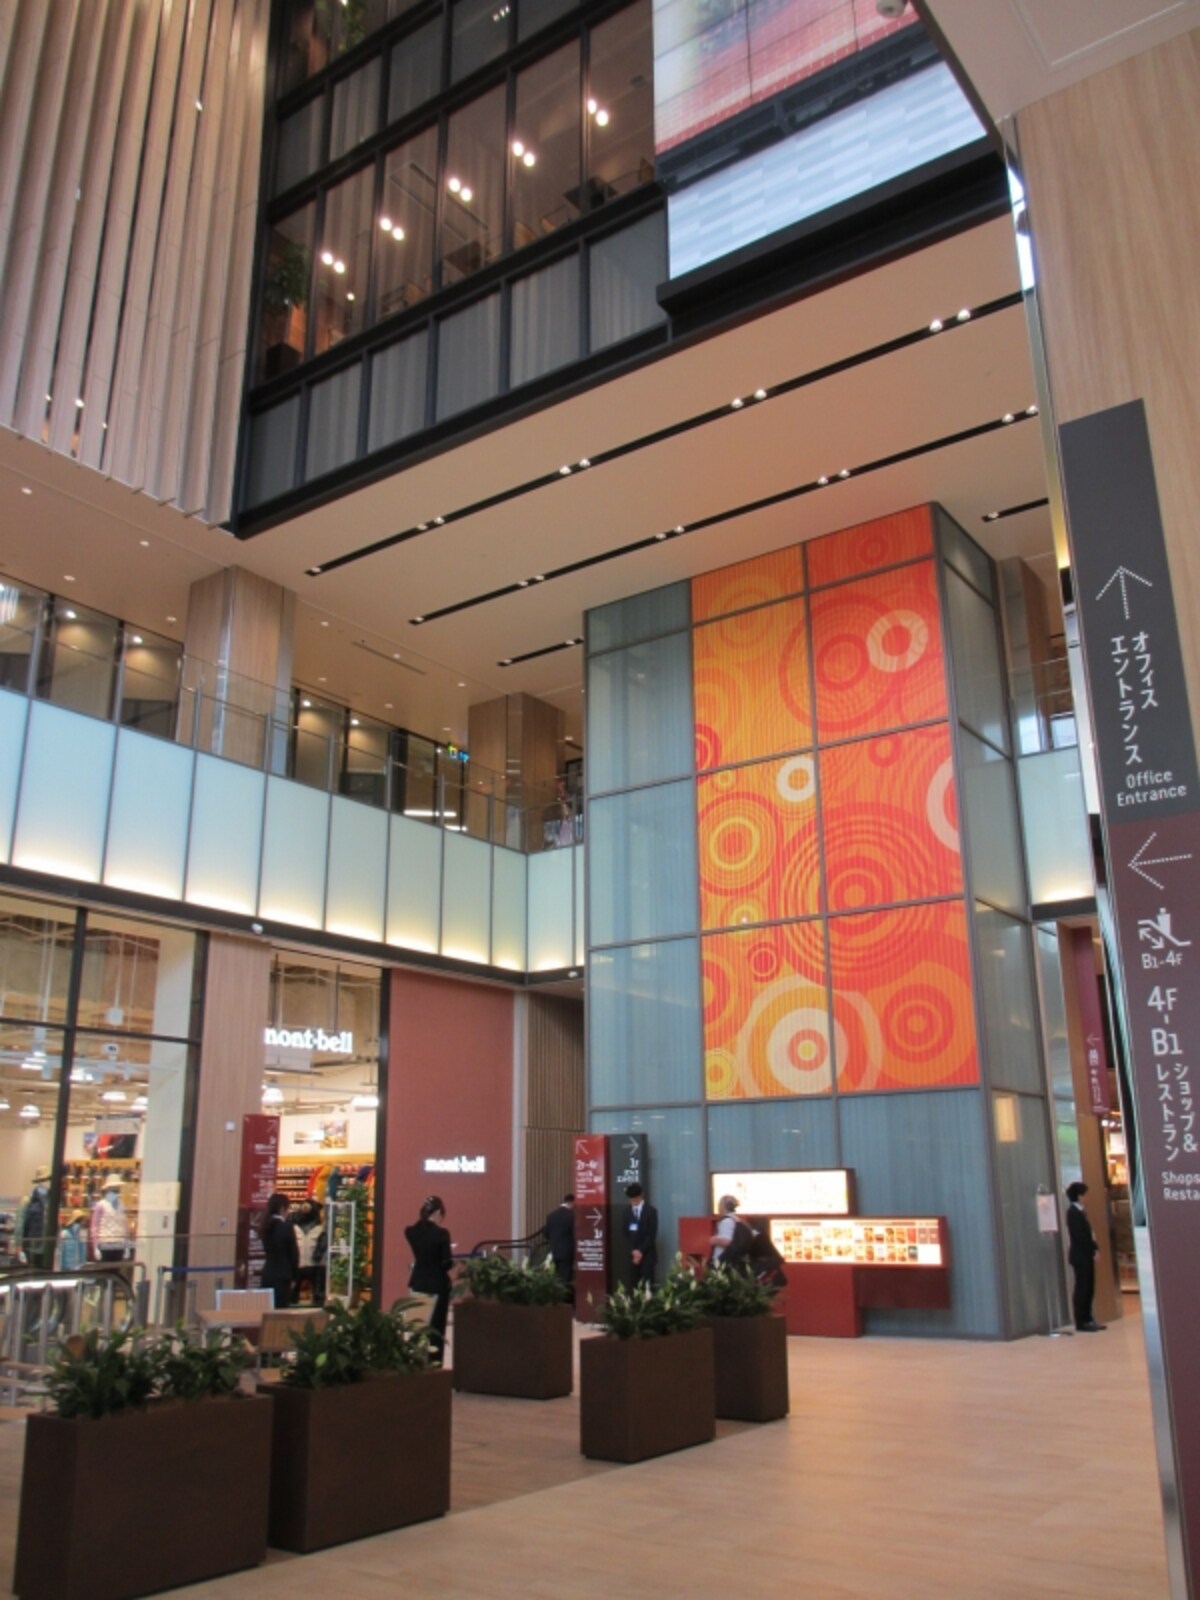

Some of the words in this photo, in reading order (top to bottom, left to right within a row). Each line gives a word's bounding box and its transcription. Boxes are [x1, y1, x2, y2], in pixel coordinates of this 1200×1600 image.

[1111, 635, 1143, 766] エントランス
[1132, 631, 1158, 710] オフィス
[1117, 785, 1187, 807] Entrance
[1126, 770, 1173, 789] Office
[1157, 1063, 1179, 1161] レストラン
